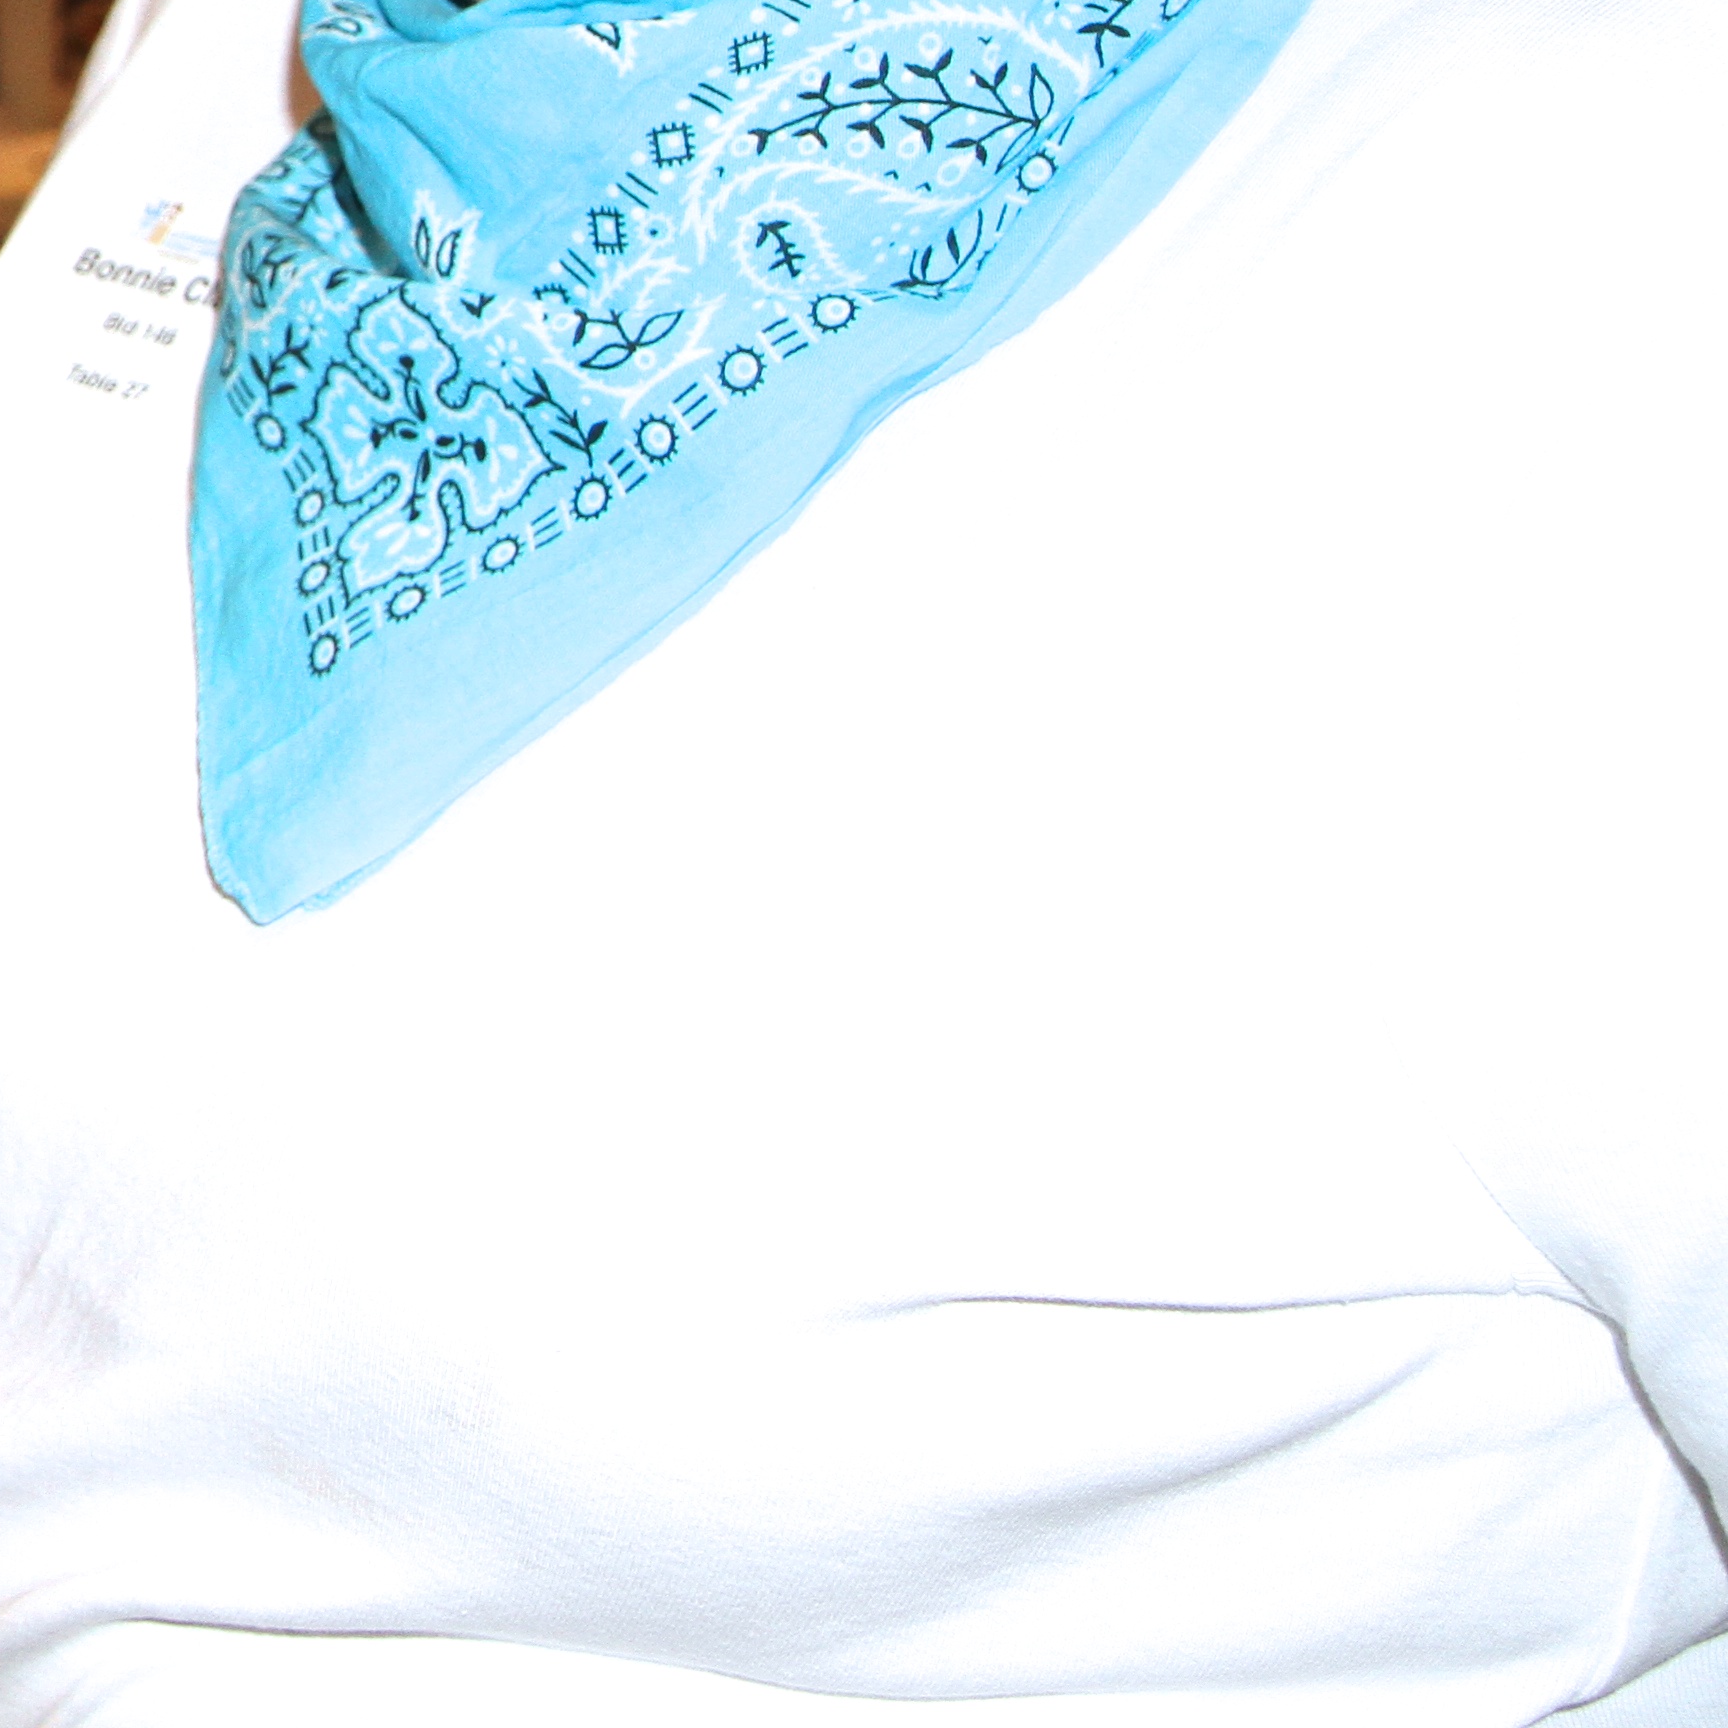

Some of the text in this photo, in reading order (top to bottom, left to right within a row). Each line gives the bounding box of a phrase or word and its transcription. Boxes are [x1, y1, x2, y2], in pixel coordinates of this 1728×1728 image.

[74, 247, 177, 296] Bonnie
[183, 275, 218, 308] C
[102, 311, 139, 337] Bid
[67, 362, 120, 394] Table
